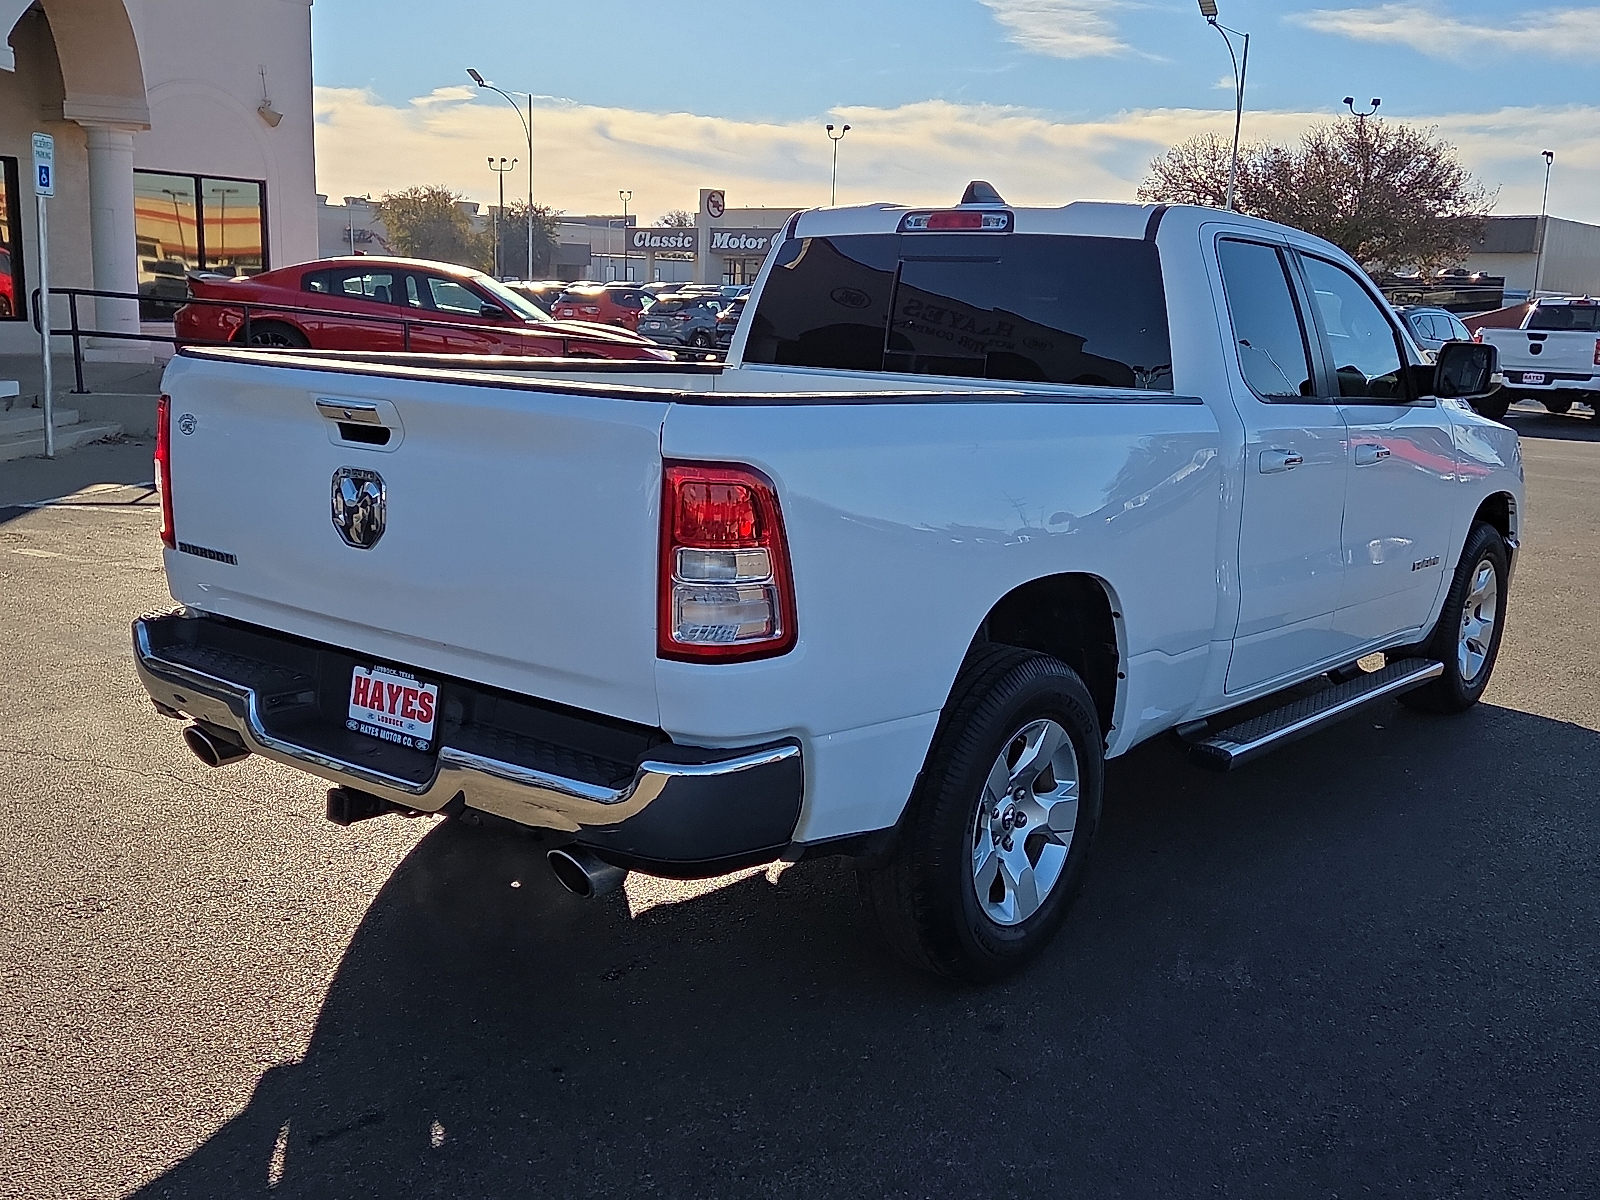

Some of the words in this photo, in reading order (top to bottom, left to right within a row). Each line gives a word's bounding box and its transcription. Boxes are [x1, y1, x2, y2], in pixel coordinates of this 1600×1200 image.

[633, 230, 693, 248] Classic
[711, 232, 768, 250] Motor
[399, 670, 415, 680] TEXAS
[352, 675, 434, 724] HAYES
[359, 723, 379, 738] HAYES
[380, 729, 402, 744] MOTOR
[402, 735, 414, 748] CO.
